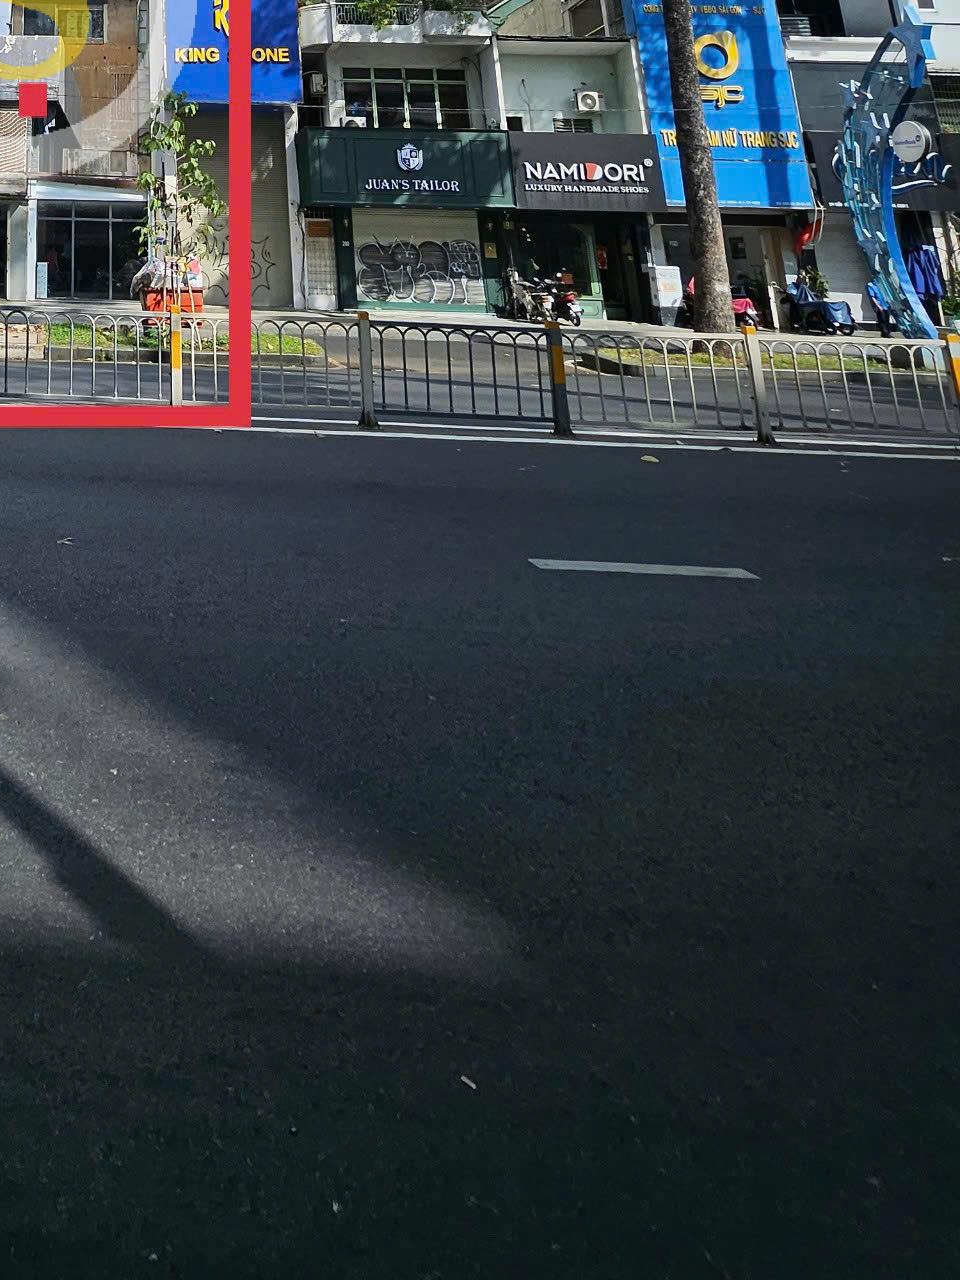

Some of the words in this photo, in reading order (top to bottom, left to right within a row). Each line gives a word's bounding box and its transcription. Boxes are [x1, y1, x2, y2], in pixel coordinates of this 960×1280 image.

[174, 47, 220, 63] KING
[740, 130, 776, 148] TRANG
[778, 131, 800, 148] SJC
[365, 179, 410, 190] JUAN'S
[412, 179, 460, 192] TAILOR
[525, 183, 563, 192] LUXURY
[564, 184, 620, 193] HANDMADE
[620, 185, 650, 194] SHOES
